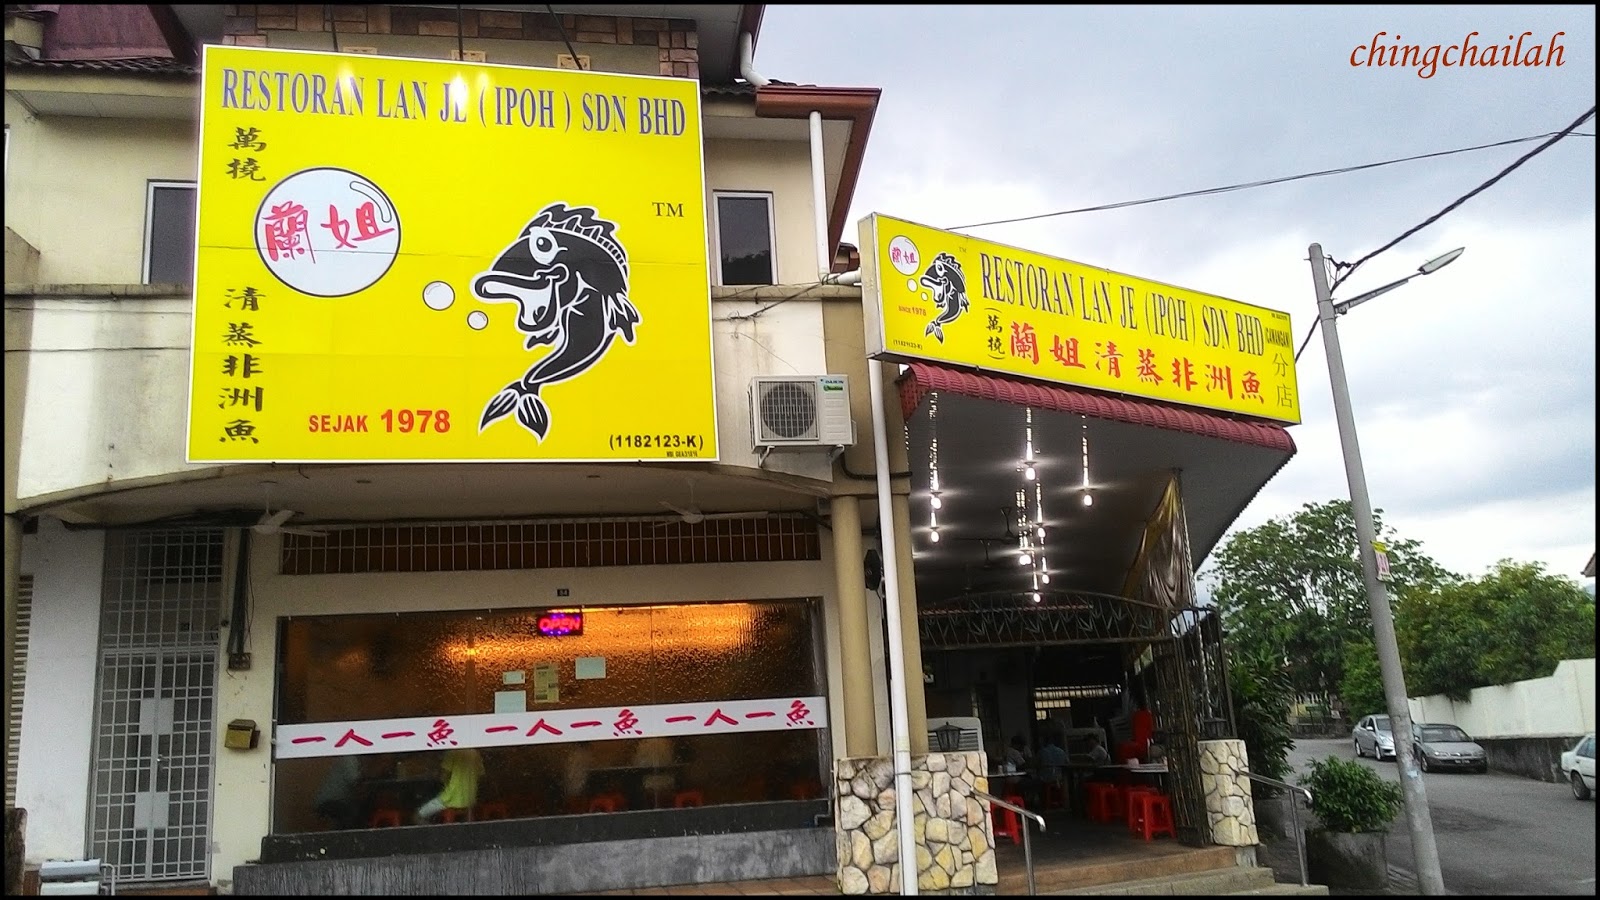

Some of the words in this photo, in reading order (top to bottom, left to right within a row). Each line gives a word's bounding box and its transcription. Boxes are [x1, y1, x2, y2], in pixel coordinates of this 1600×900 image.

[222, 69, 365, 117] RESTORAN
[377, 78, 428, 121] LAN
[582, 92, 627, 132] SDN
[638, 97, 686, 136] BHD
[261, 200, 396, 265] 蘭姐
[652, 201, 685, 218] TM
[980, 252, 1075, 317] RESTORAN
[1079, 274, 1112, 326] LAN
[1119, 285, 1139, 330] JE
[1202, 306, 1230, 350] SDN
[1236, 313, 1265, 357] BHD
[218, 286, 267, 445] 清蒸非洲魚
[1010, 320, 1265, 404] 蘭姐清蒸非洲魚
[1272, 353, 1293, 408] 分店
[308, 413, 369, 433] SEJAK
[380, 409, 451, 434] 1978
[609, 434, 704, 451] (1182123-K)
[539, 616, 580, 631] OPEN
[291, 719, 458, 748] 一人一魚
[484, 708, 643, 738] 一人一魚
[665, 699, 816, 728] 一人一魚
